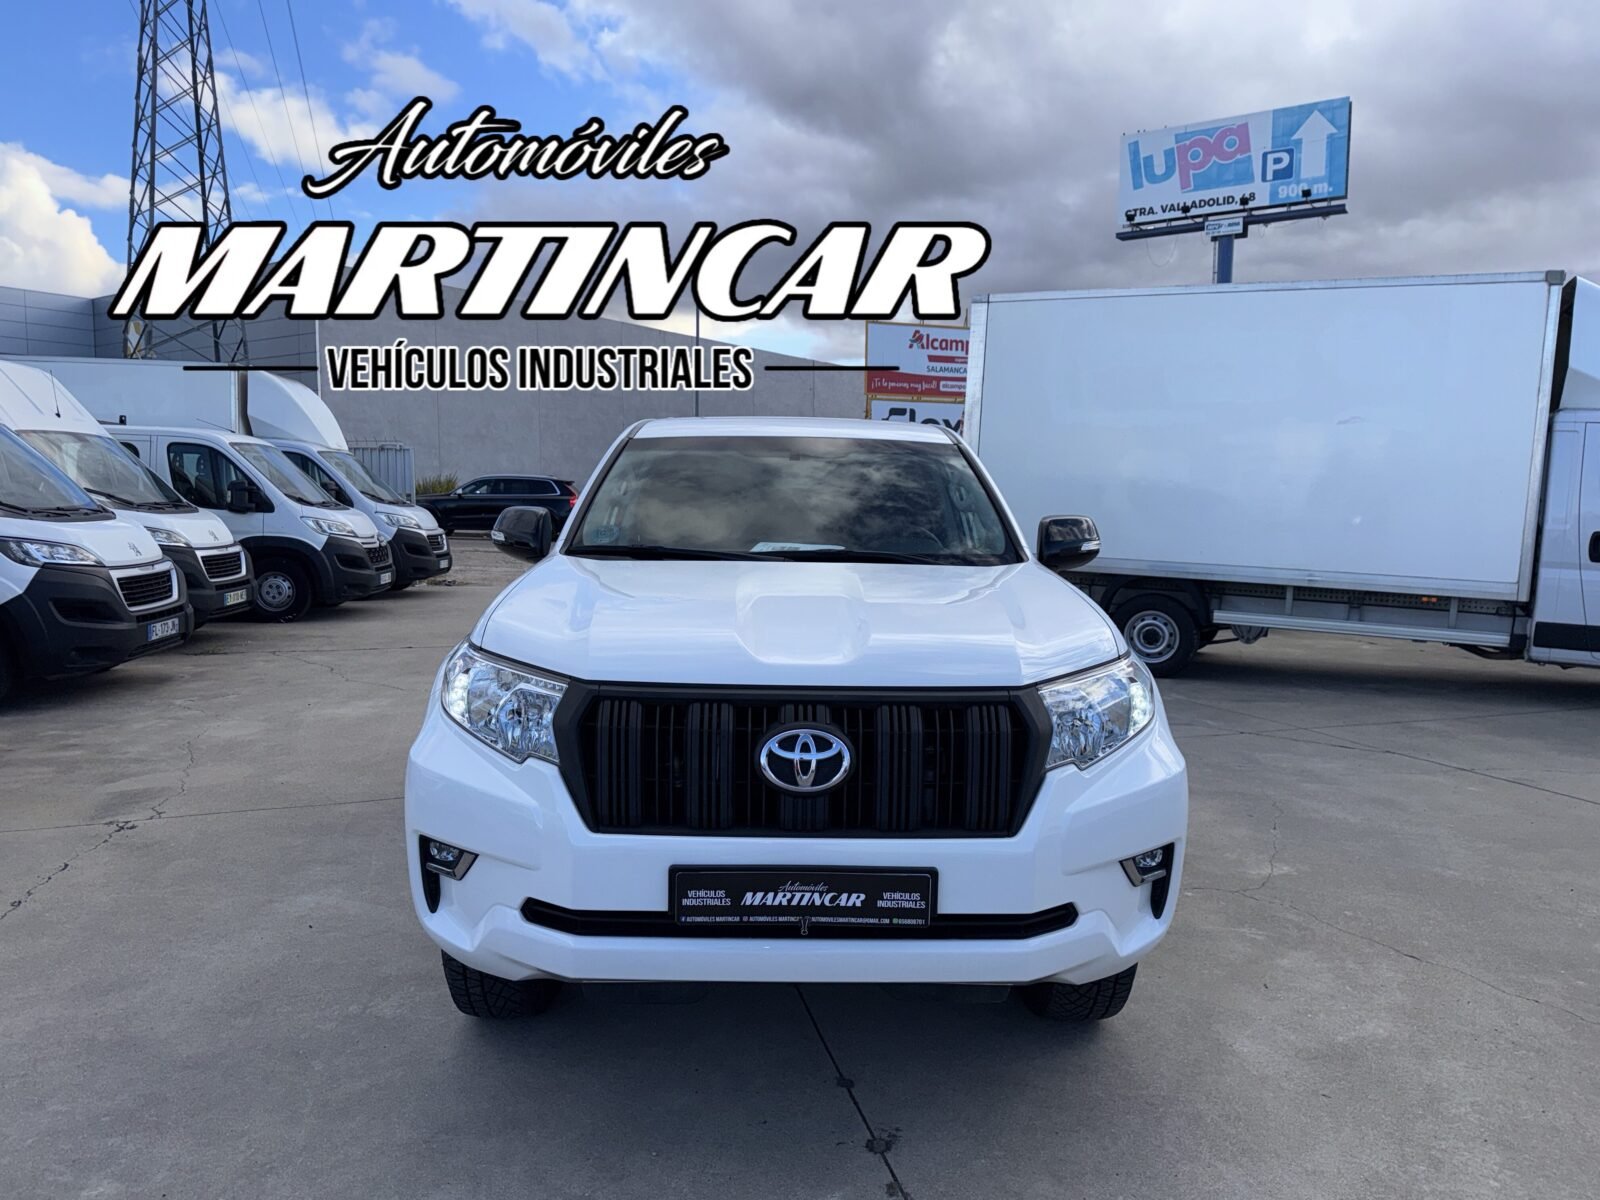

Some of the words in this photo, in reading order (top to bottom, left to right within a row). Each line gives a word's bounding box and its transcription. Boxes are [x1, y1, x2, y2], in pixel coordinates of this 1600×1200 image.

[1128, 121, 1252, 191] lupa
[926, 366, 967, 374] SALAMANCA
[778, 881, 829, 893] Automóviles
[687, 889, 726, 898] VEHÍCULOS
[883, 891, 921, 901] VEHÍCULOS
[682, 898, 731, 906] INDUSTRIALES
[740, 891, 866, 907] MARTINCAR
[877, 900, 926, 909] INDUSTRIALES
